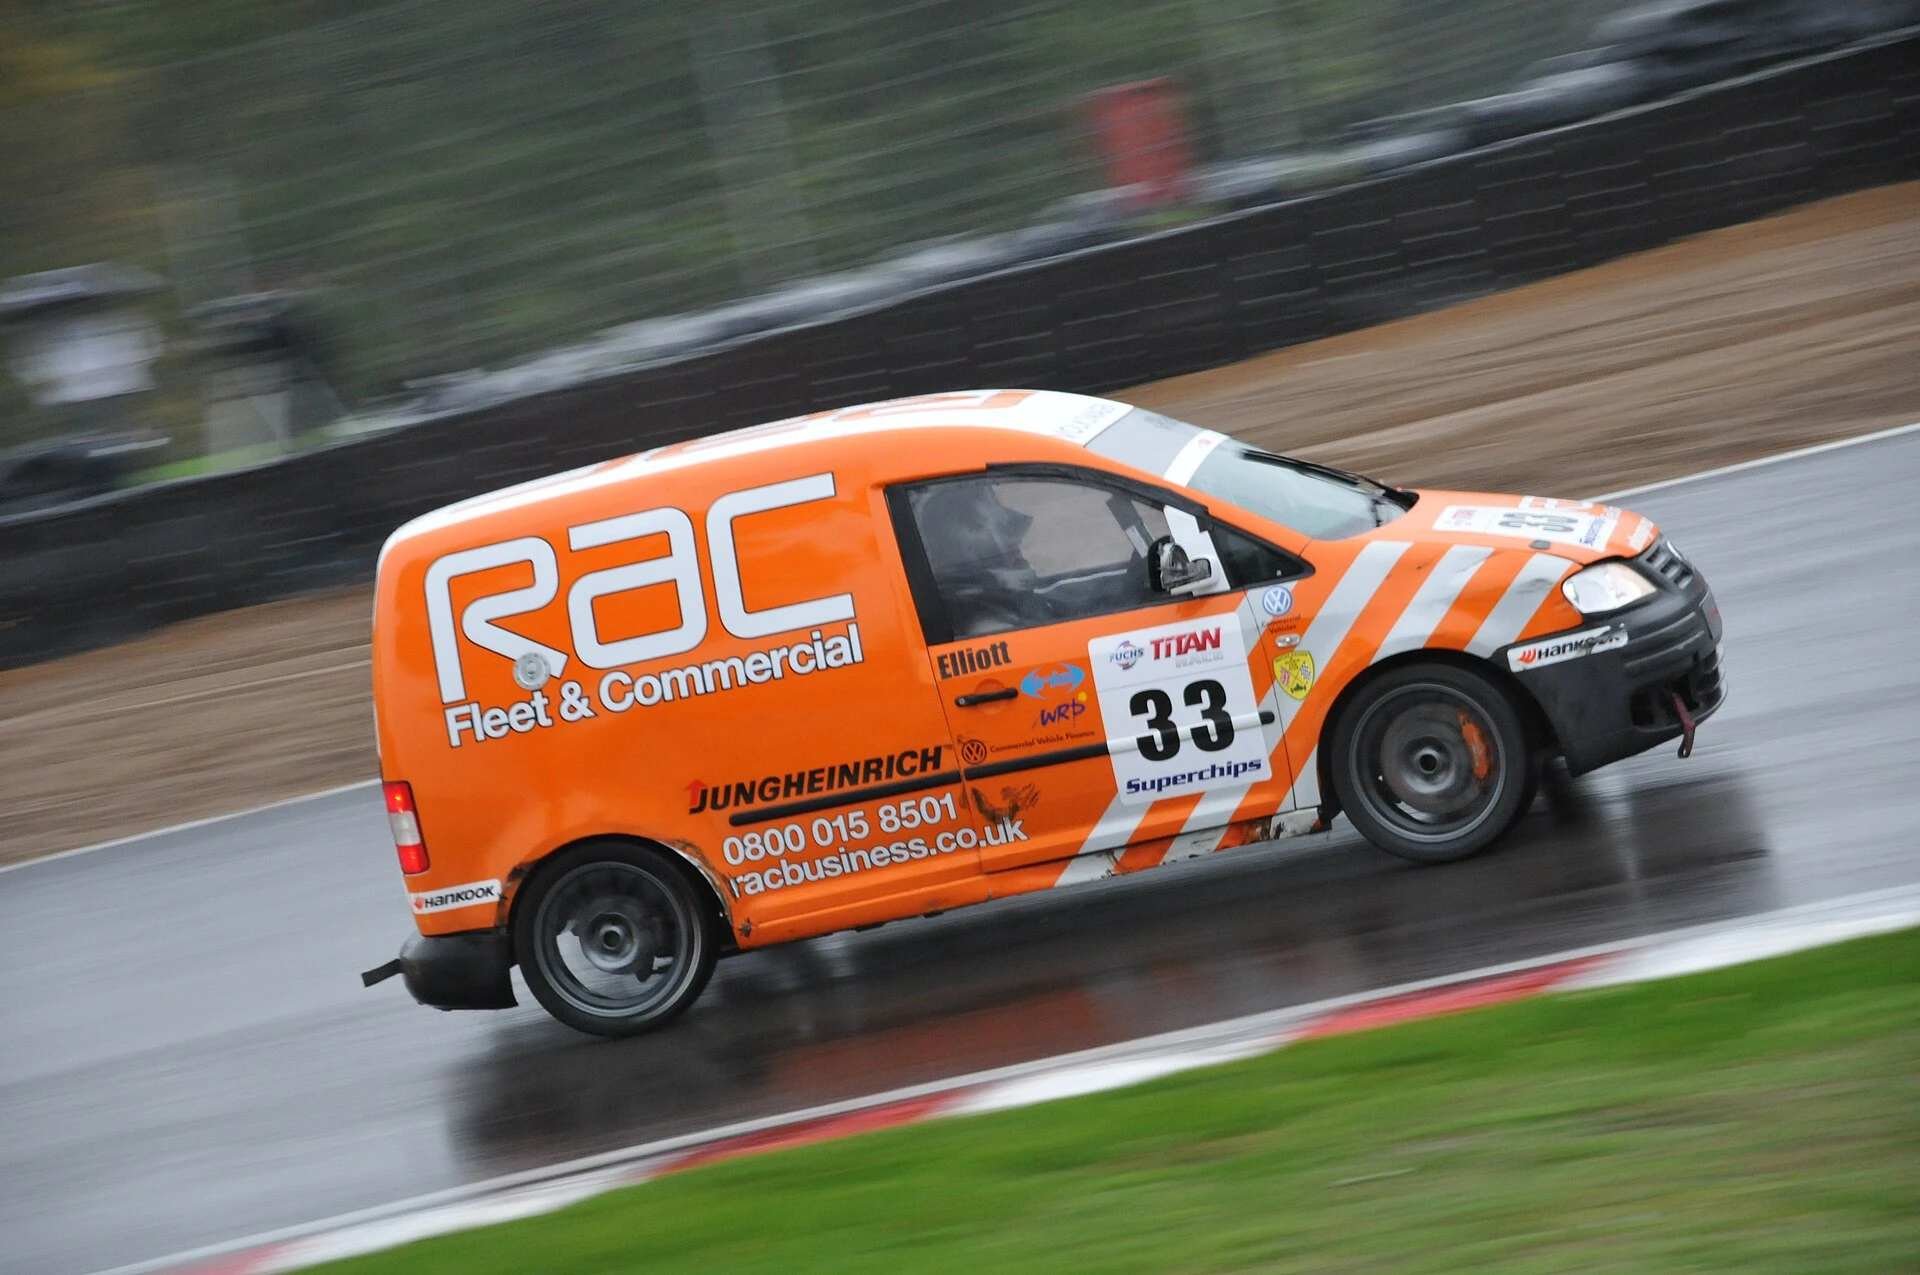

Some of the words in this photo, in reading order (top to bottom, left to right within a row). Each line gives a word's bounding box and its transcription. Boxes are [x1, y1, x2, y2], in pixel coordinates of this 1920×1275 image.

[937, 640, 1012, 680] Elliott
[1109, 647, 1144, 663] FUCHS
[1175, 652, 1223, 668] RACE
[443, 688, 554, 748] Fleet
[558, 680, 598, 722] &
[598, 622, 865, 714] Commercial
[989, 737, 1035, 753] Commercial
[1036, 732, 1064, 744] Vehicle
[1065, 729, 1095, 740] Finance
[1129, 679, 1235, 762] 33
[689, 745, 943, 815] JUNGHEINRICH
[1126, 759, 1262, 794] Superchips
[722, 823, 805, 867] 0800
[811, 811, 870, 844] 015
[878, 792, 958, 833] 8501
[729, 816, 1029, 899] racbusiness.co.uk
